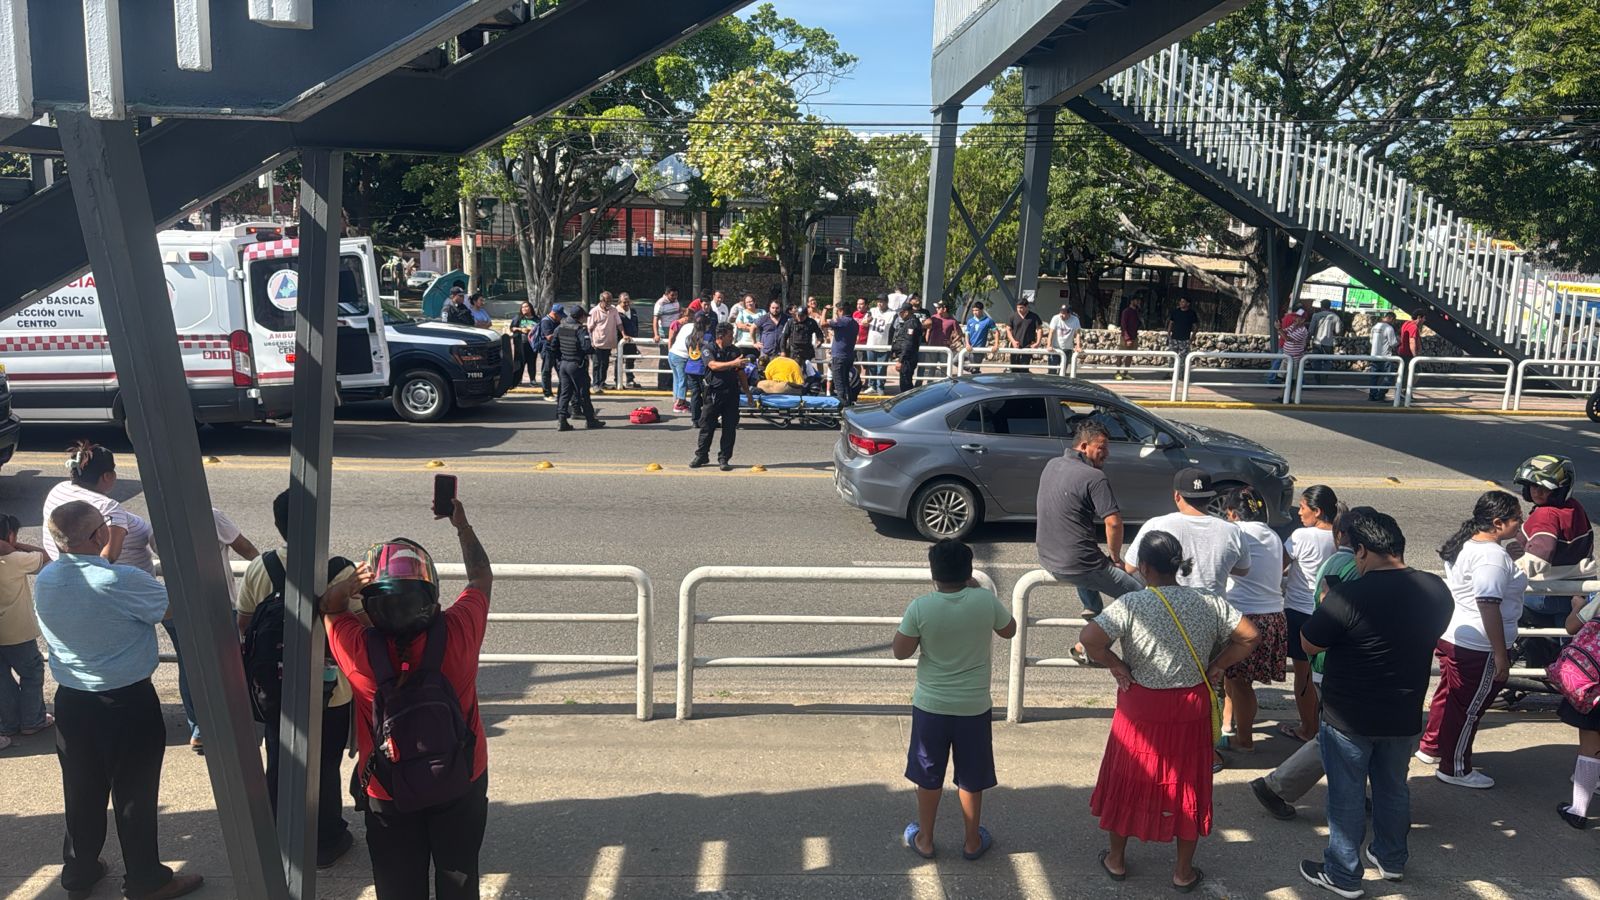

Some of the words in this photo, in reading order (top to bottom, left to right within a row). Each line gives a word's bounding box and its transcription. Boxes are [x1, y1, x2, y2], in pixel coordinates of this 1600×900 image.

[46, 296, 95, 305] BASICAS
[13, 308, 55, 317] ECCIÓN
[57, 309, 84, 317] CIVIL
[872, 318, 886, 333] 12
[204, 351, 230, 359] 911
